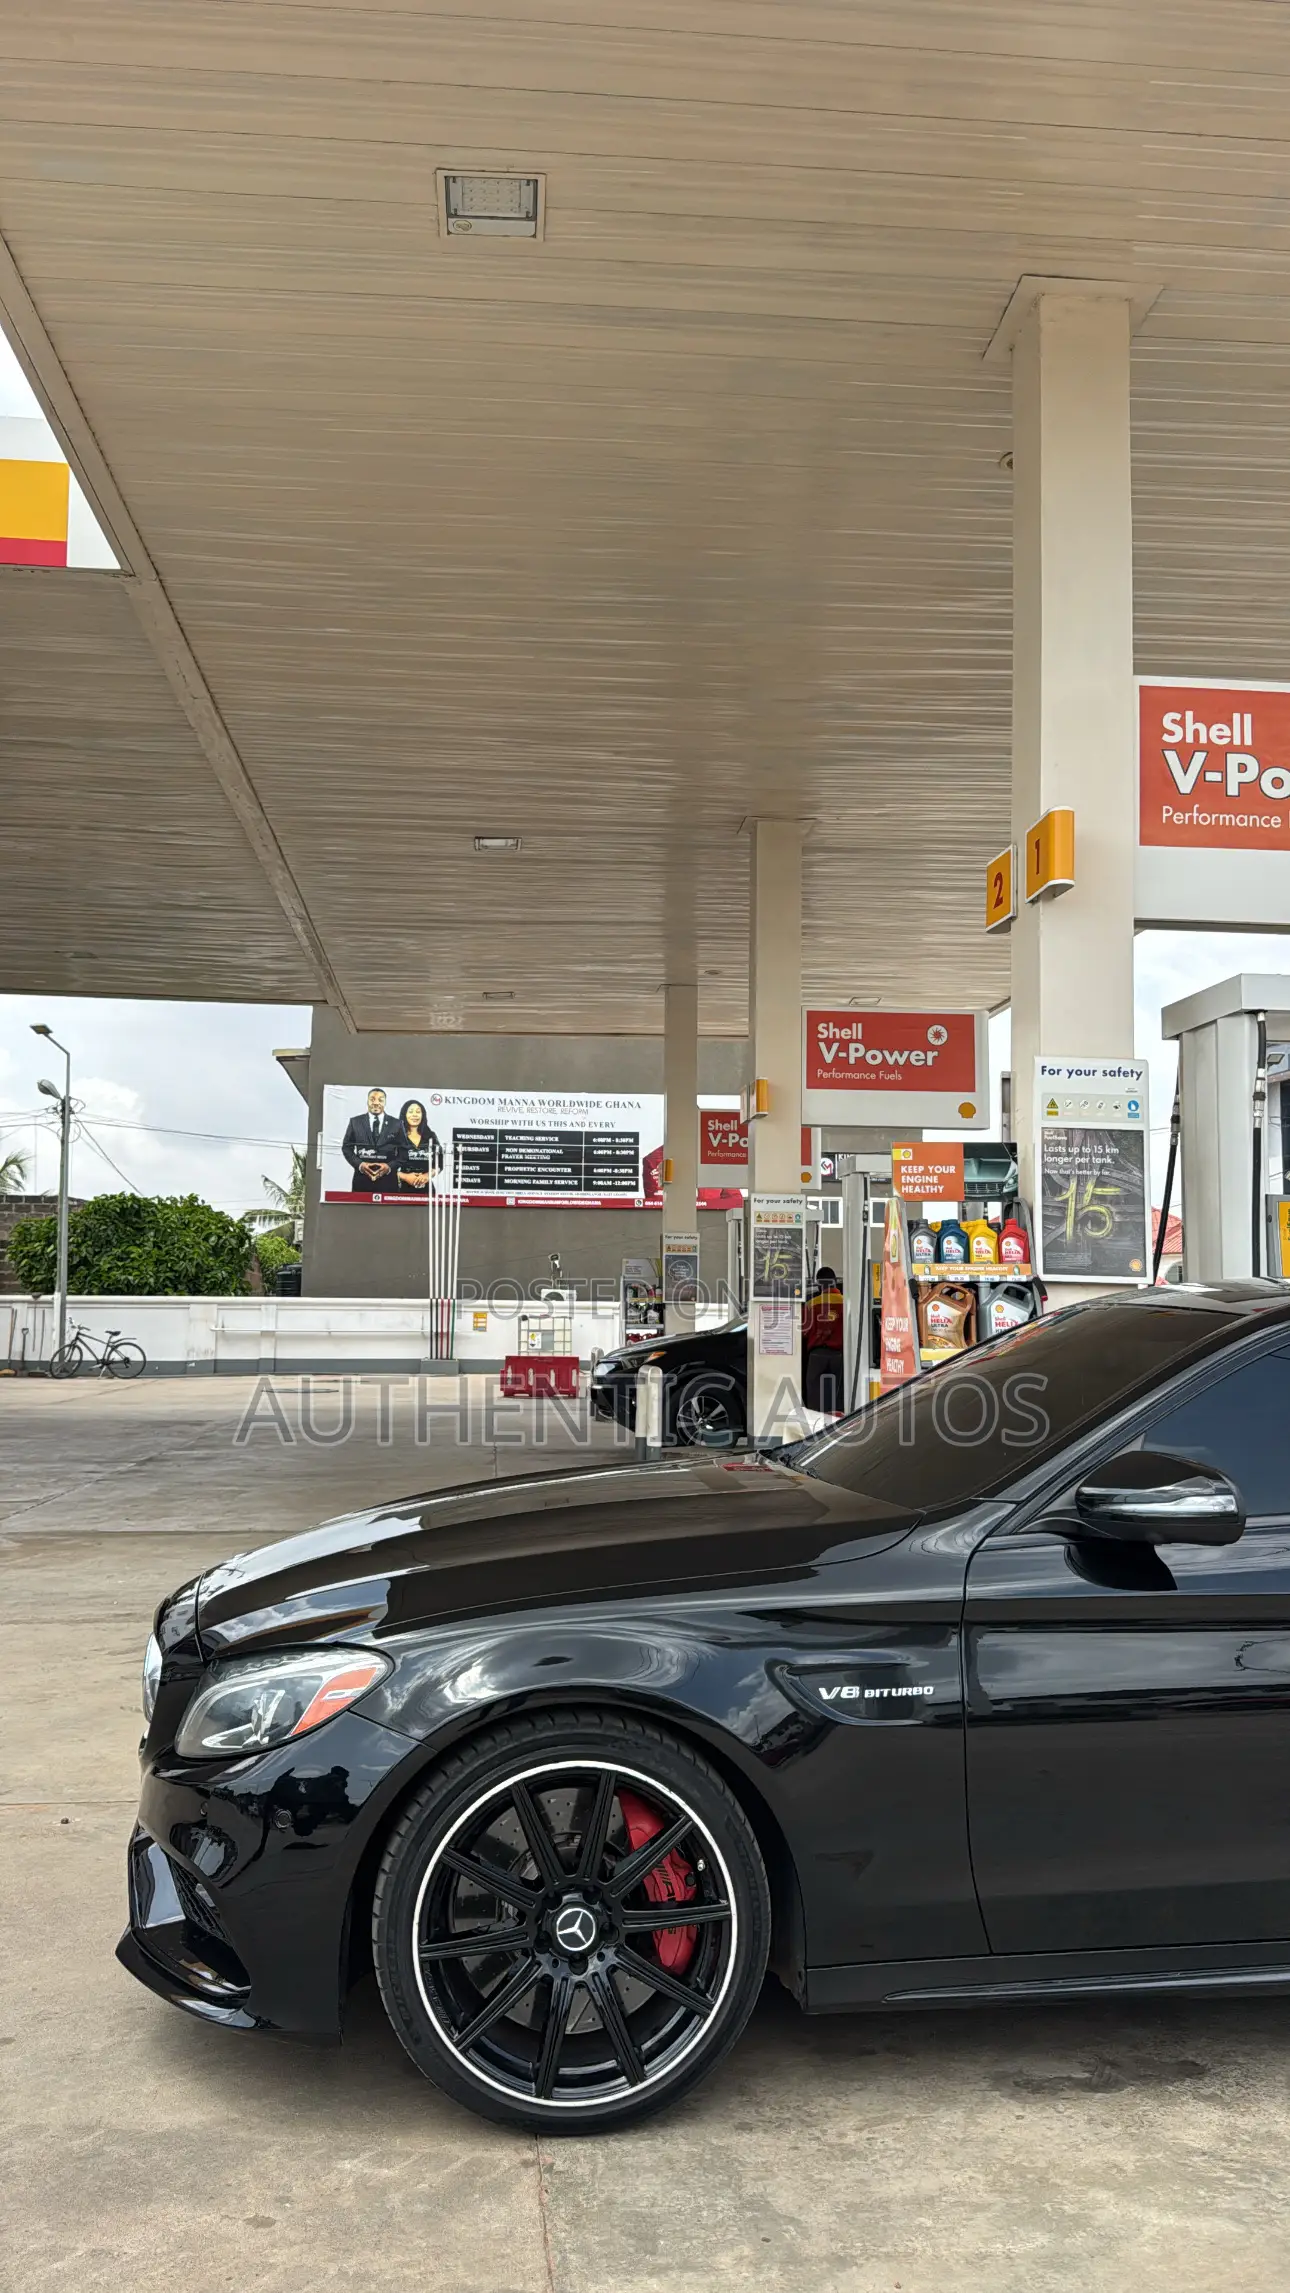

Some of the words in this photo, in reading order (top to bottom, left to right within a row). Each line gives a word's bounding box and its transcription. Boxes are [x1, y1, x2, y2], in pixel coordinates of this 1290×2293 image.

[1162, 711, 1253, 746] Shell
[1162, 804, 1282, 829] Performance
[1035, 839, 1041, 875] 1
[993, 872, 1004, 909] 2
[817, 1023, 863, 1040] Shell
[818, 1042, 938, 1067] V-Power
[817, 1069, 876, 1081] Performance
[879, 1071, 902, 1082] Fuels
[1041, 1066, 1062, 1076] For
[1066, 1067, 1098, 1079] your
[1102, 1066, 1144, 1081] safety
[445, 1096, 495, 1106] KINGDOM
[498, 1098, 535, 1107] MANNA
[537, 1099, 602, 1109] WORLDWIDE
[605, 1101, 641, 1109] GHANA
[470, 1118, 509, 1126] WORSHIP
[511, 1119, 534, 1127] WITH
[548, 1120, 567, 1128] THIS
[568, 1120, 586, 1128] AND
[707, 1119, 738, 1131] Shell
[707, 1149, 747, 1158] Performance
[1044, 1143, 1066, 1153] Lasts
[1068, 1145, 1080, 1155] up
[1082, 1145, 1091, 1154] to
[1094, 1145, 1103, 1153] 15
[1105, 1145, 1120, 1154] km
[1044, 1153, 1073, 1164] longer
[1075, 1156, 1090, 1165] per
[1092, 1155, 1115, 1164] tank.
[900, 1165, 925, 1174] KEEP
[928, 1165, 956, 1174] YOUR
[901, 1175, 939, 1184] ENGINE
[901, 1184, 944, 1194] HEALTHY
[818, 1686, 860, 1700] V8
[863, 1686, 936, 1698] BITURBO
